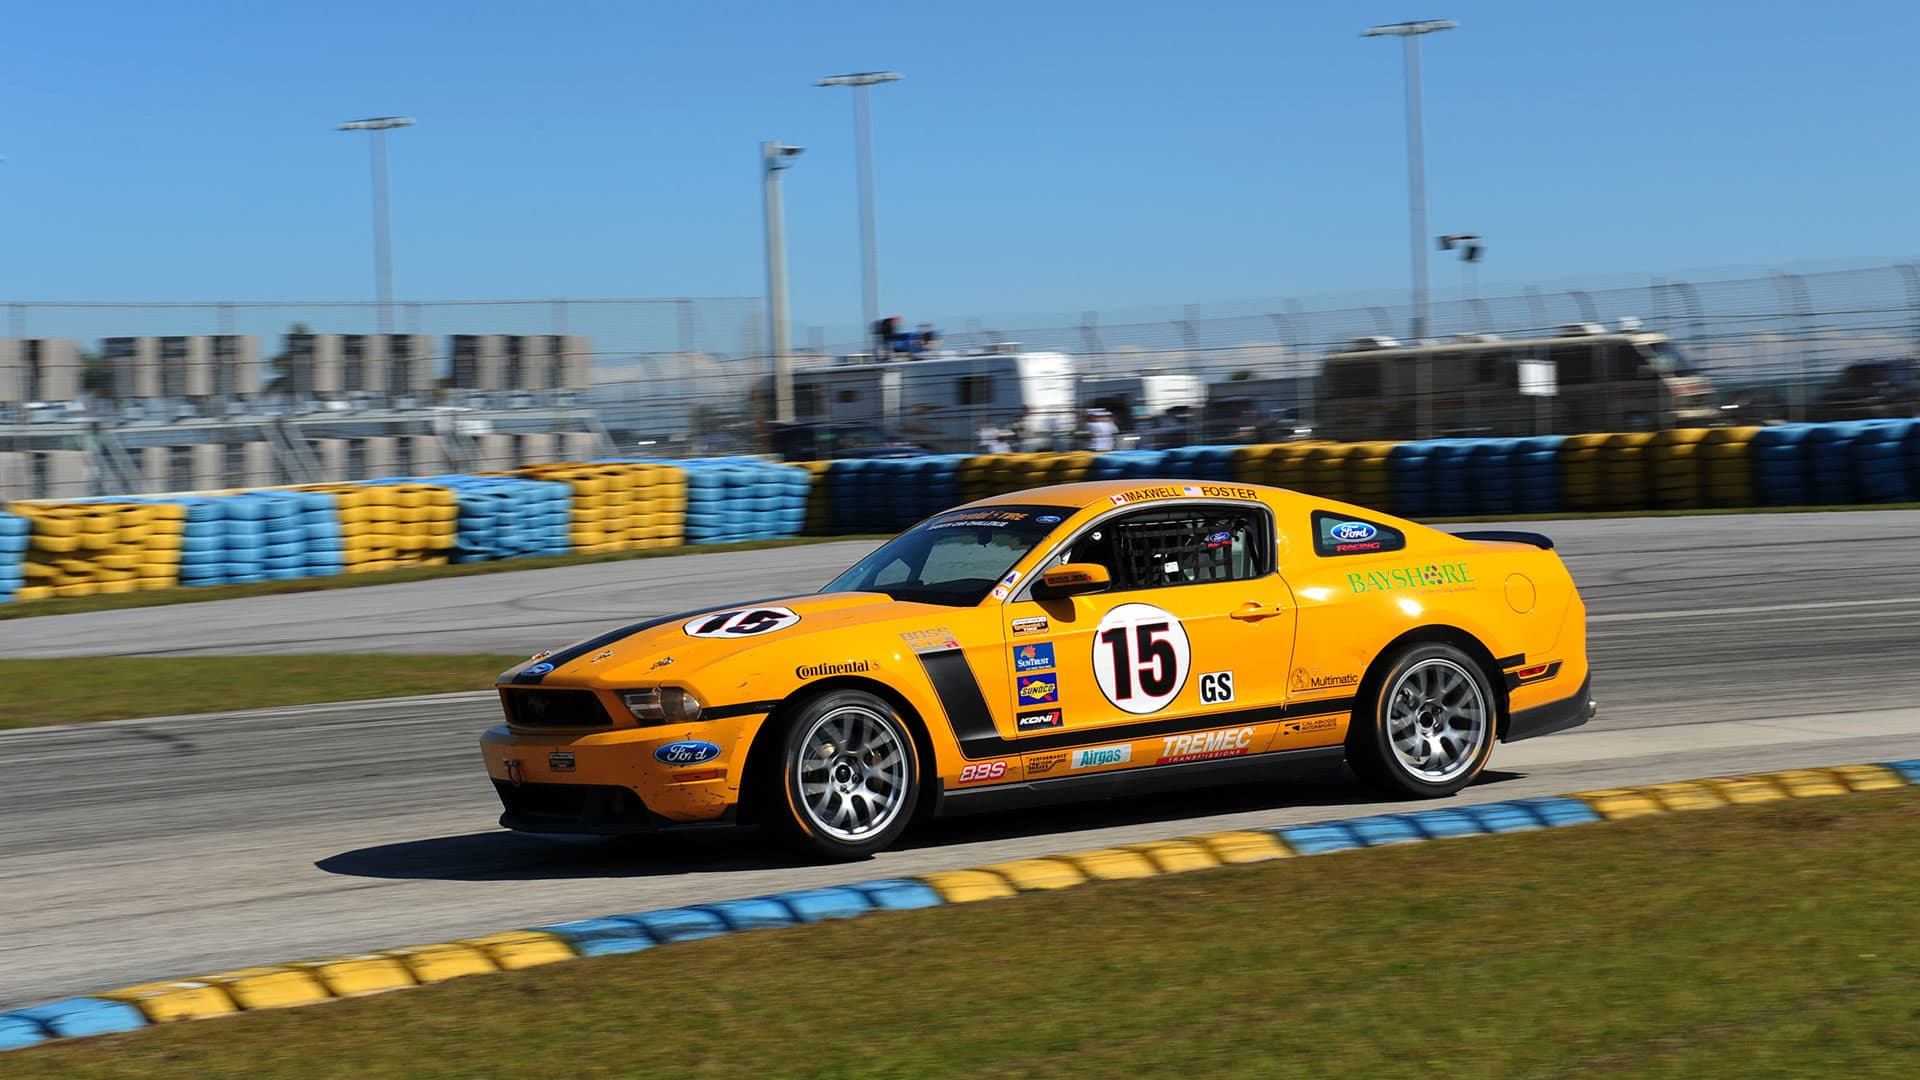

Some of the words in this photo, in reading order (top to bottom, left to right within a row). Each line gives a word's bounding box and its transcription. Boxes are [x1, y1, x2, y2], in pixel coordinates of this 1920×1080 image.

[1125, 486, 1181, 502] MAXWELL
[1201, 486, 1258, 500] FOSTER
[1340, 525, 1369, 539] Ford
[1336, 541, 1381, 552] RACING
[695, 610, 789, 635] 15
[1101, 621, 1177, 701] 15
[795, 660, 869, 680] Continental
[1201, 673, 1232, 702] GS
[1311, 673, 1358, 687] Multimatic
[1021, 684, 1055, 696] SUNOCO
[1019, 714, 1053, 726] KONI
[1162, 727, 1254, 757] TREMEC
[667, 744, 708, 761] Ford
[1080, 748, 1122, 767] Airgas
[1168, 749, 1241, 763] TRANSMISSIONS
[960, 761, 1006, 782] BBS
